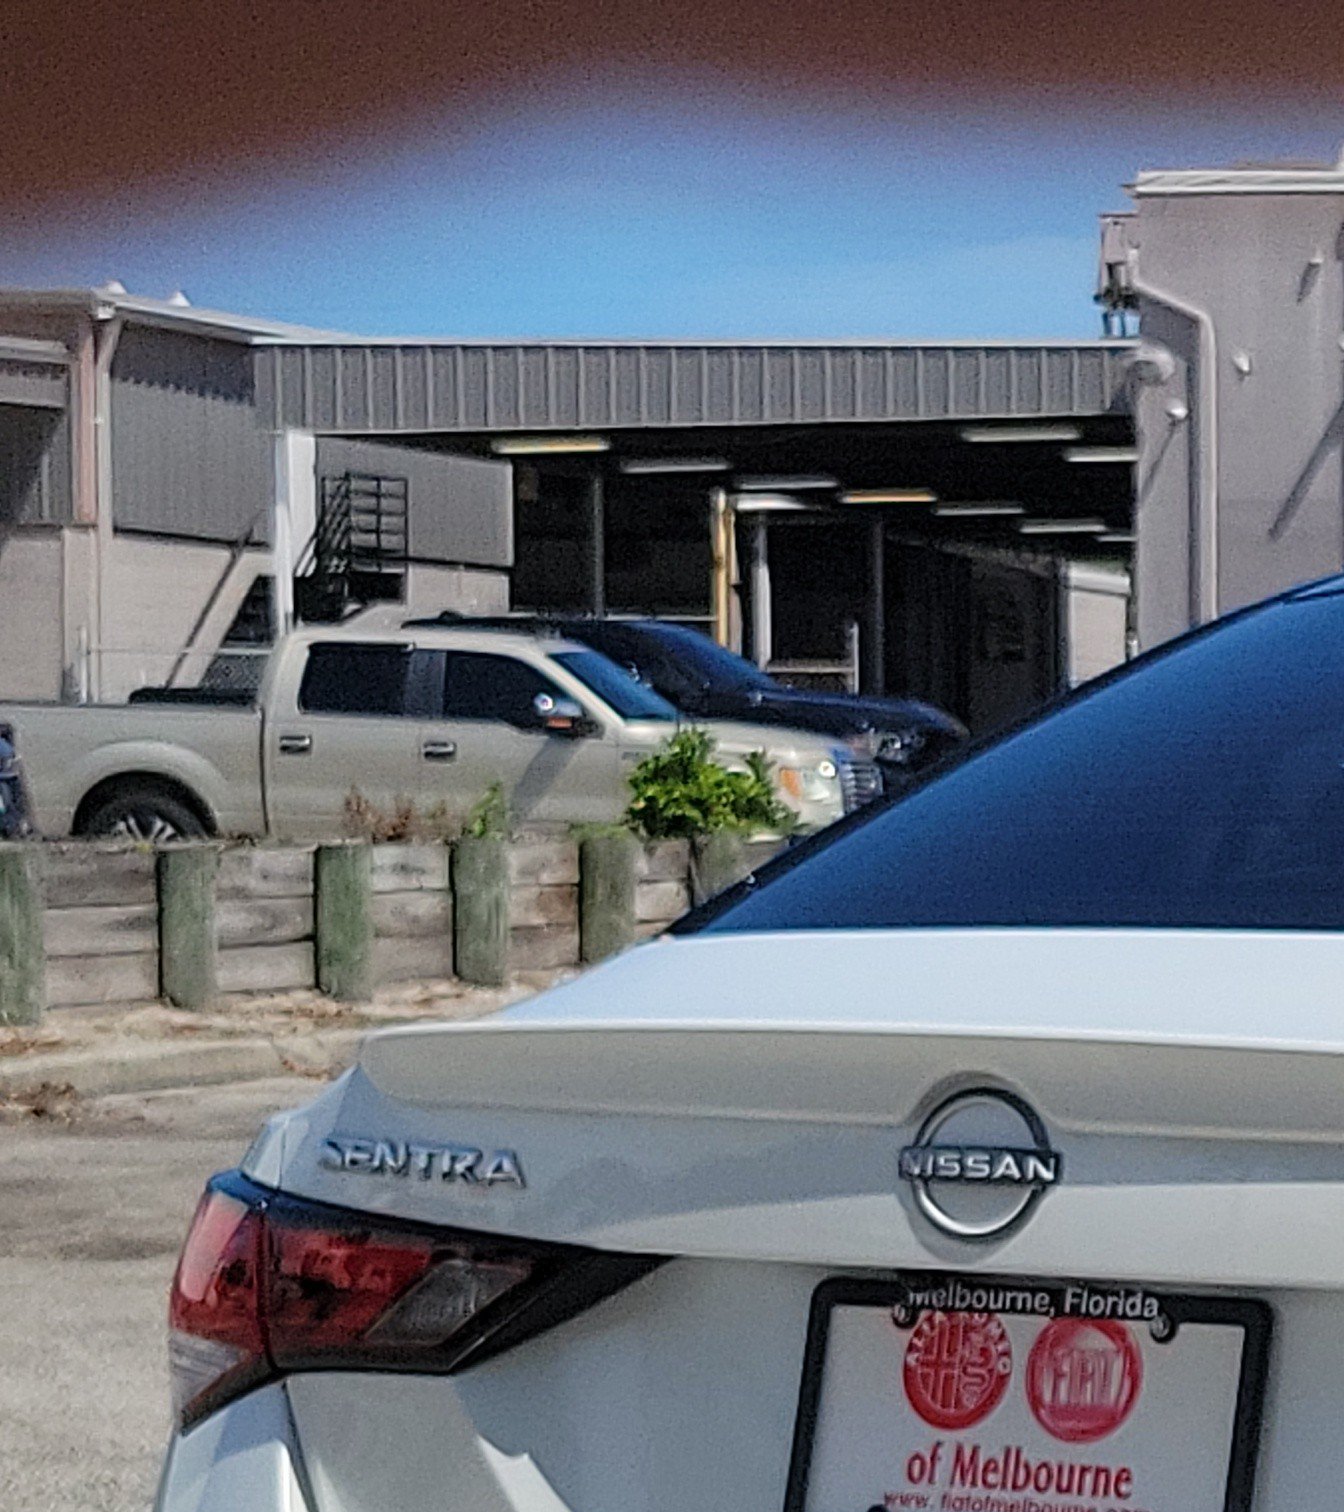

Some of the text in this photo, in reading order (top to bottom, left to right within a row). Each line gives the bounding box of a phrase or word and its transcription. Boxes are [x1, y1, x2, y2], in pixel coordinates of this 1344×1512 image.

[318, 1138, 528, 1191] SENTRA
[901, 1150, 1058, 1182] NISSAN
[1062, 1286, 1162, 1318] Florida
[906, 1442, 1134, 1500] of Melbourne
